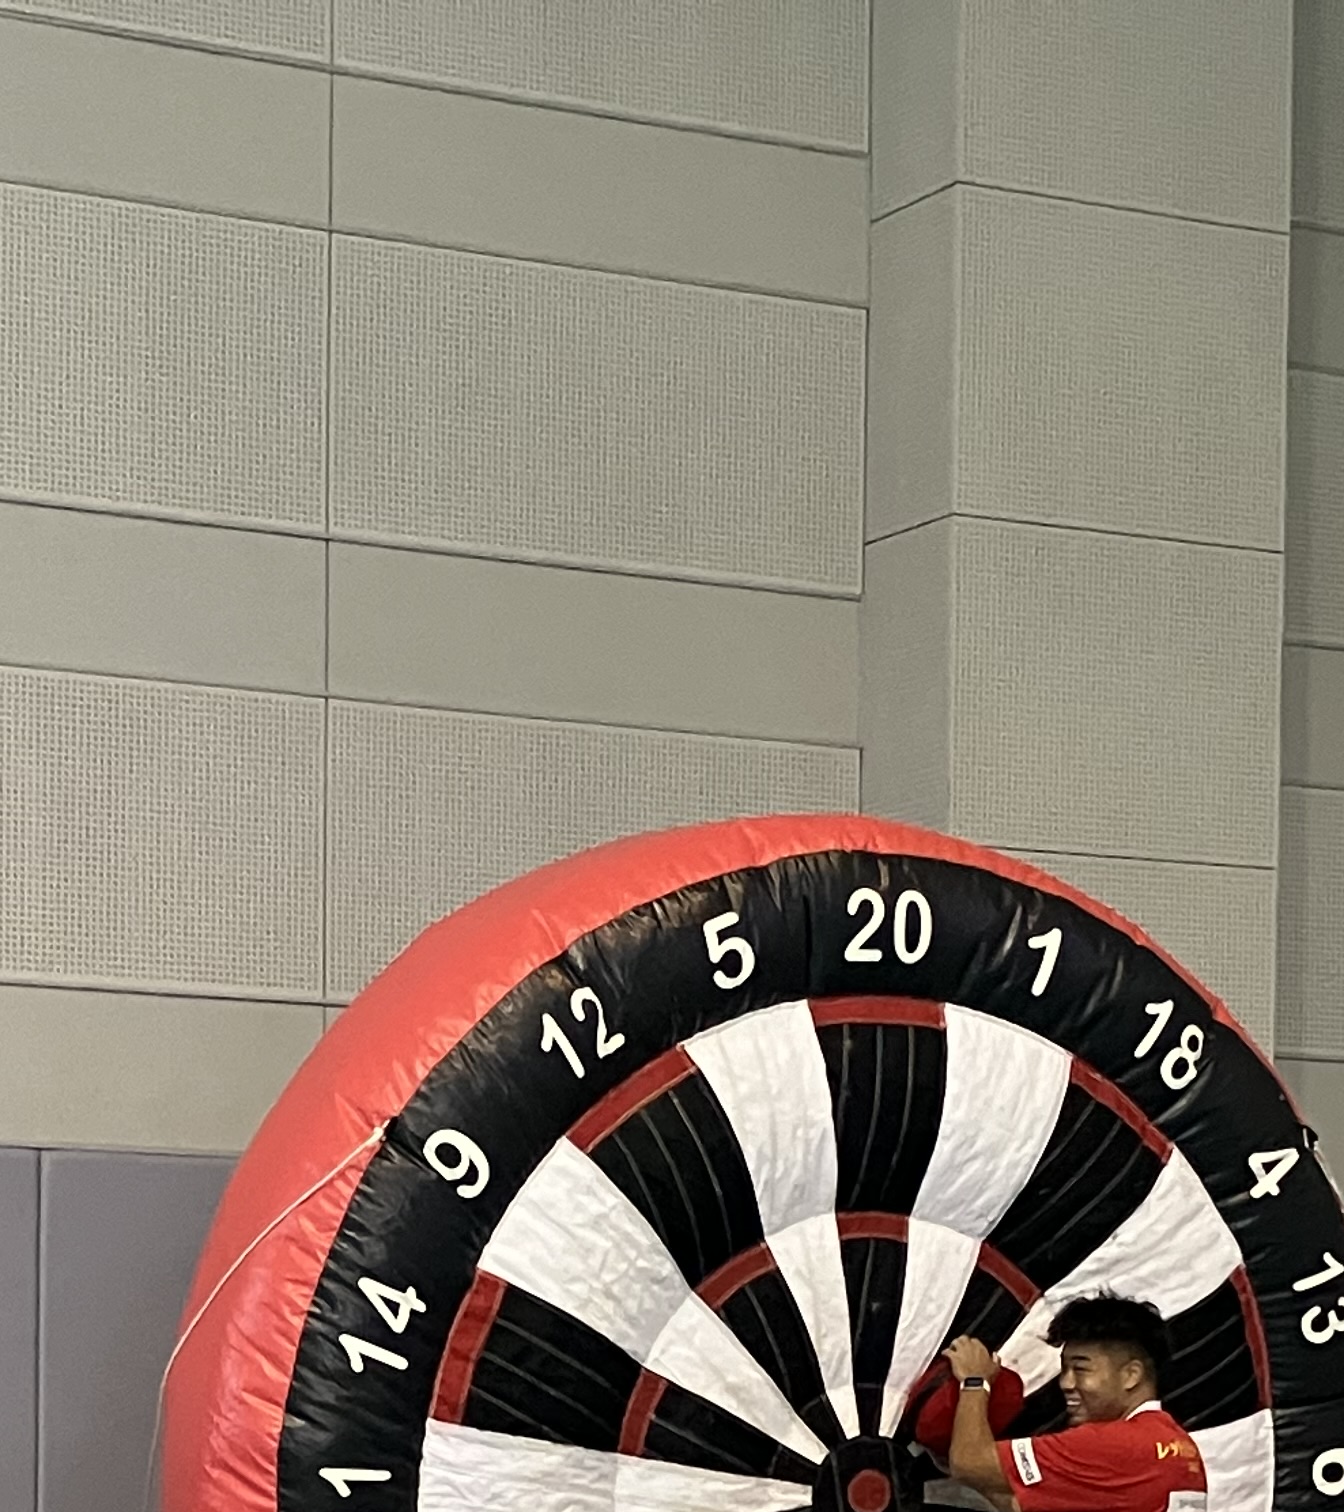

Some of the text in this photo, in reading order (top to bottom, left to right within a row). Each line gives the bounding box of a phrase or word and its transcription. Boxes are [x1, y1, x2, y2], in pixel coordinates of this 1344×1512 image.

[702, 911, 756, 990] 5
[844, 887, 933, 965] 20
[1027, 927, 1062, 997] 1
[540, 986, 626, 1079] 12
[1133, 999, 1205, 1090] 18
[422, 1128, 490, 1199] 9
[1248, 1147, 1300, 1199] 4
[338, 1276, 427, 1373] 14
